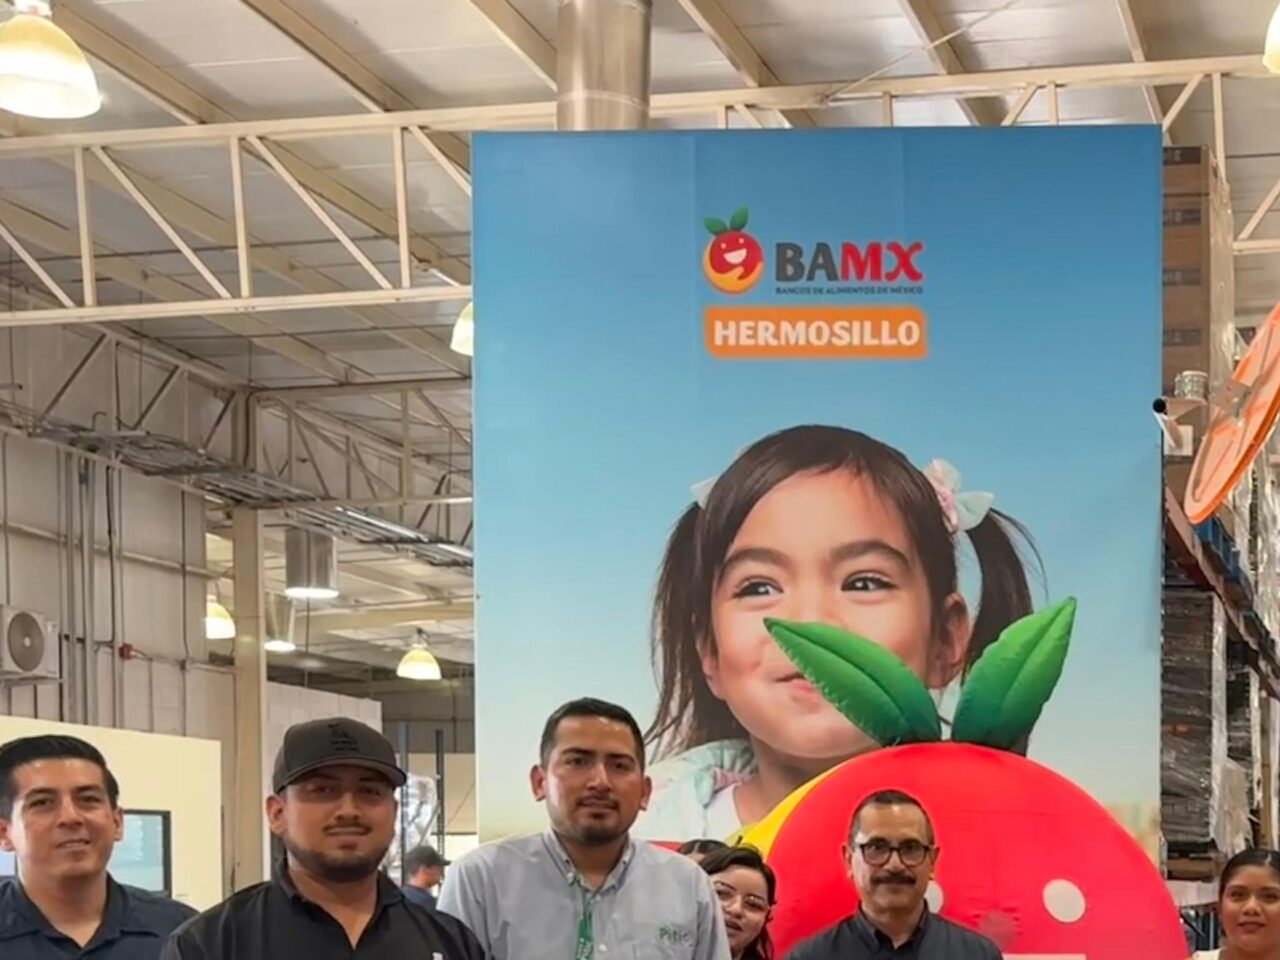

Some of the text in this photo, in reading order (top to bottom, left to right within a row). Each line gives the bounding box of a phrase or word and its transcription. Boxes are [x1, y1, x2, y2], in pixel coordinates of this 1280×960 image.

[775, 242, 924, 282] BAMX
[776, 286, 811, 294] BANCOS
[826, 286, 875, 294] ALIMENTOS
[714, 320, 920, 346] HERMOSILLO
